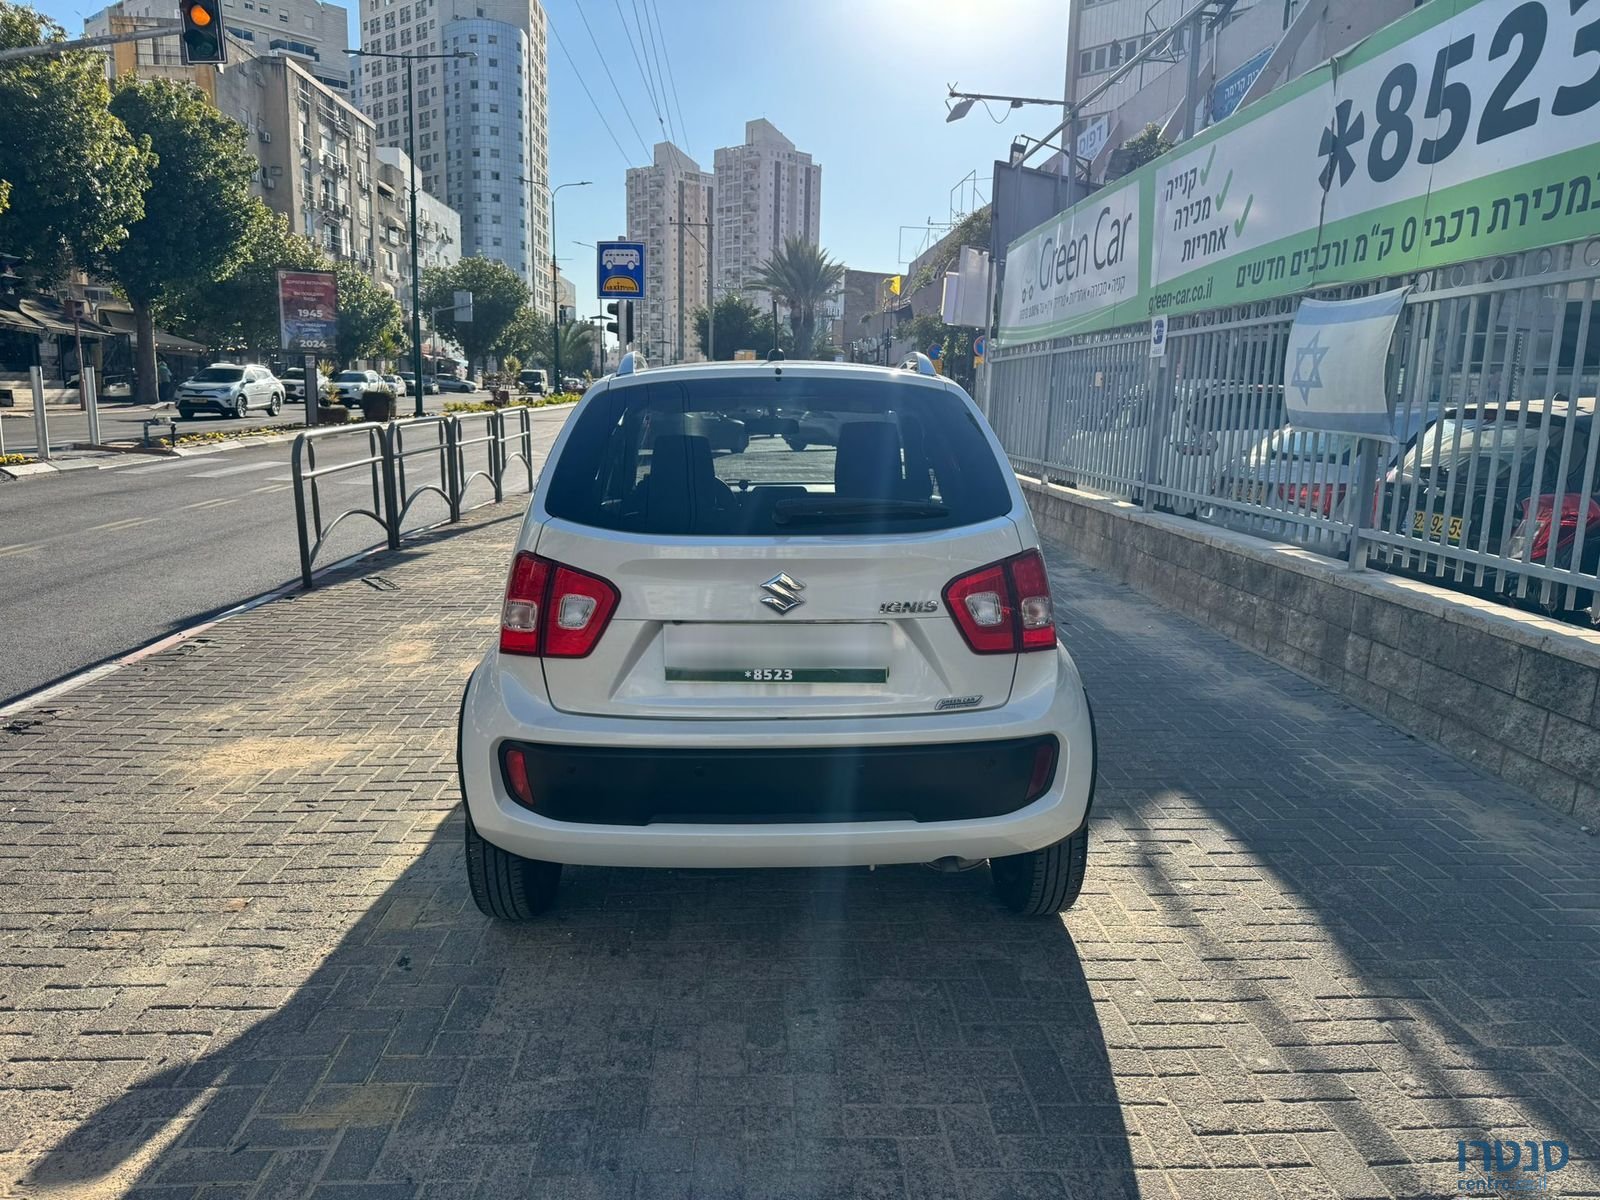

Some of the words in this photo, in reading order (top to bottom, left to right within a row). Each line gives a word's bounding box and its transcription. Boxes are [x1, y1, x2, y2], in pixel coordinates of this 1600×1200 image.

[1079, 124, 1103, 155] דפוס
[1165, 167, 1198, 202] קנייה
[1174, 195, 1211, 232] מכירה
[1424, 206, 1480, 247] רכבי
[1040, 233, 1089, 291] Green
[1093, 206, 1133, 270] Car
[1181, 225, 1229, 263] אחריות
[1401, 216, 1417, 252] 0
[1236, 254, 1286, 288] חדשים
[1290, 238, 1348, 276] ורכבים
[297, 309, 323, 318] 1945
[1148, 276, 1213, 315] green-car.co.il
[299, 340, 327, 348] 2024
[879, 600, 938, 614] IGNIS
